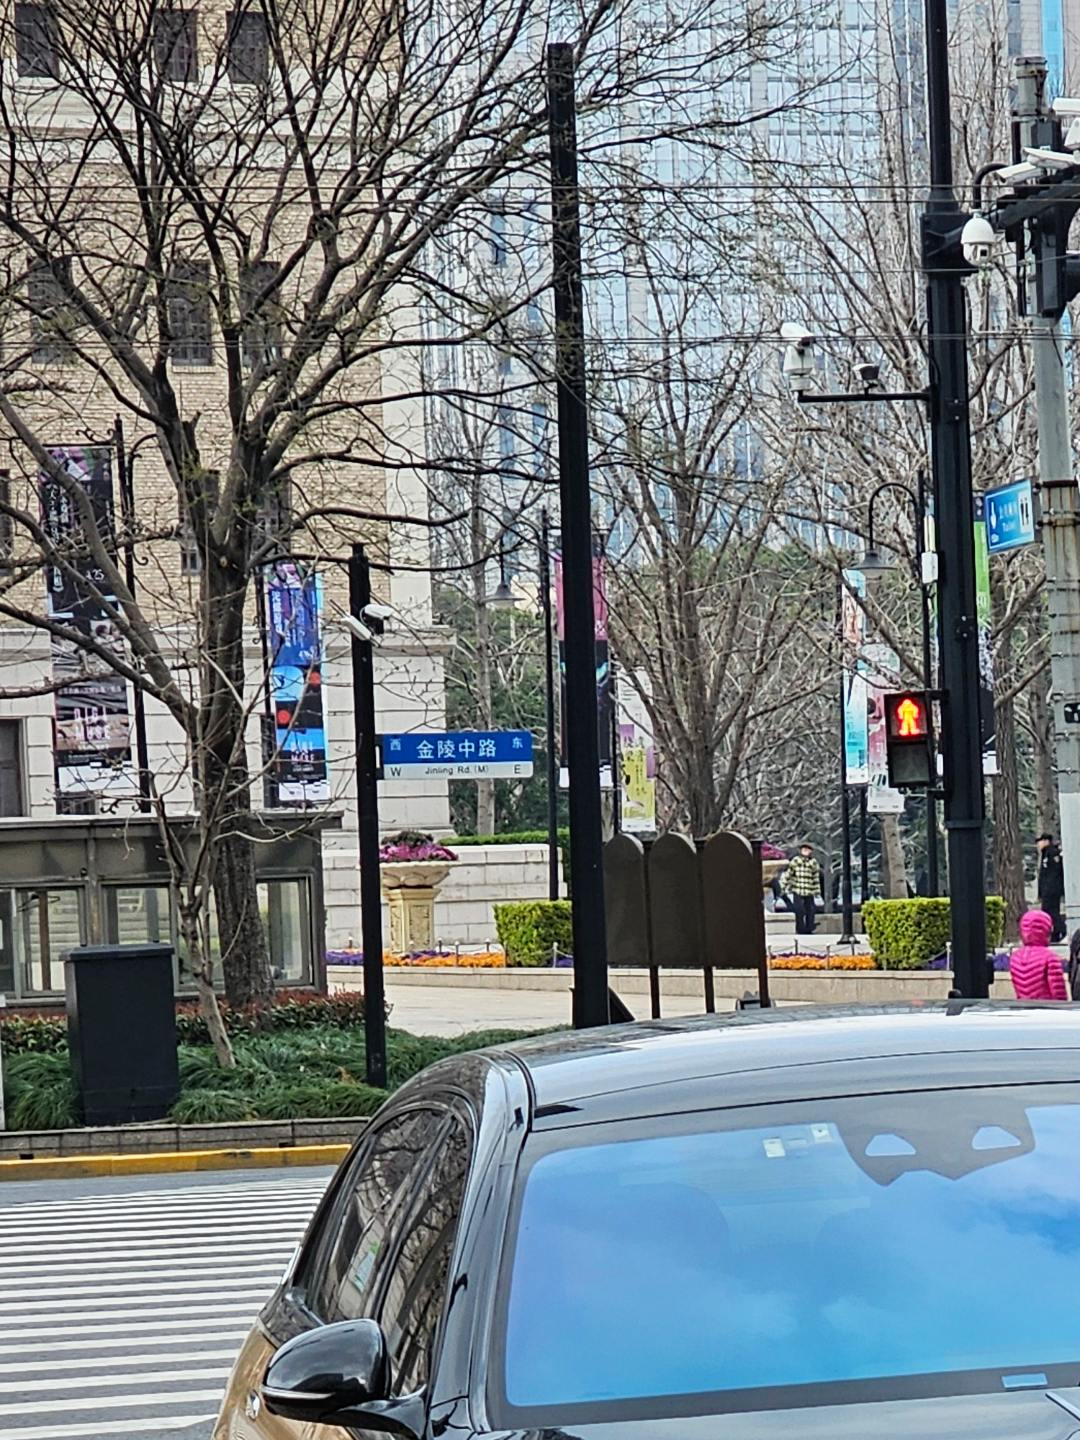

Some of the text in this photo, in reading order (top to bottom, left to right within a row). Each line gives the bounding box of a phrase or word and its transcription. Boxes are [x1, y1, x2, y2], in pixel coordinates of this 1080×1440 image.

[390, 736, 523, 760] 西 金陵中路 东
[390, 767, 401, 777] W
[425, 766, 453, 776] Jinling
[514, 764, 521, 774] E
